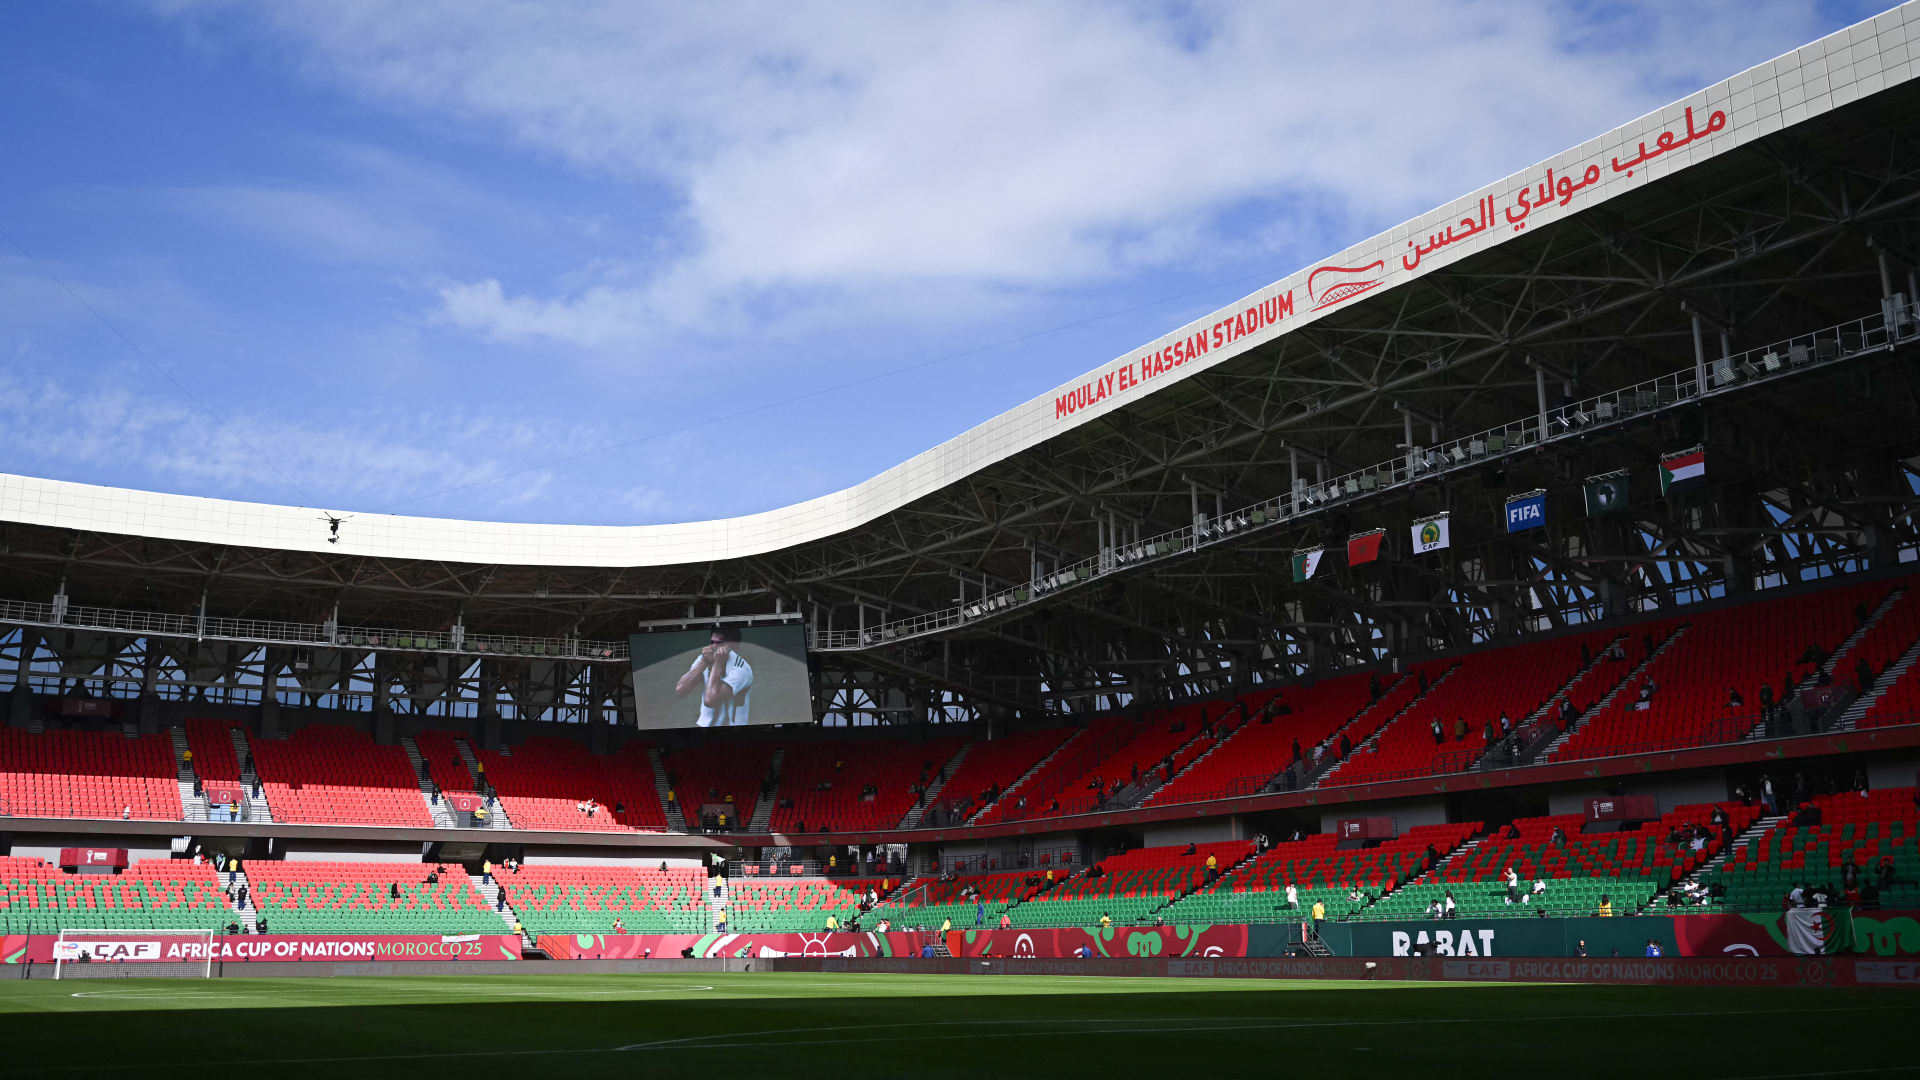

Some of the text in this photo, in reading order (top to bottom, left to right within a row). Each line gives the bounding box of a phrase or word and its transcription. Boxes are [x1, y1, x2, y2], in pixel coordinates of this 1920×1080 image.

[1402, 106, 1727, 271] ملعب مولاي الحسن
[1055, 289, 1294, 420] MOULAY EL HASSAN STADIUM
[1510, 504, 1540, 524] FIFA
[1422, 542, 1439, 551] CAF
[94, 941, 483, 957] CAF AFRICA CUP OF NATIONS MOROCCO 25
[1392, 929, 1495, 957] RABAT
[1216, 962, 1248, 975] AFRICA
[1249, 962, 1268, 975] CUP
[1269, 962, 1283, 975] OF
[1284, 962, 1325, 975] NATIONS
[1467, 962, 1778, 981] CAF AFRICA CUP OF NATIONS MOROCCO 25
